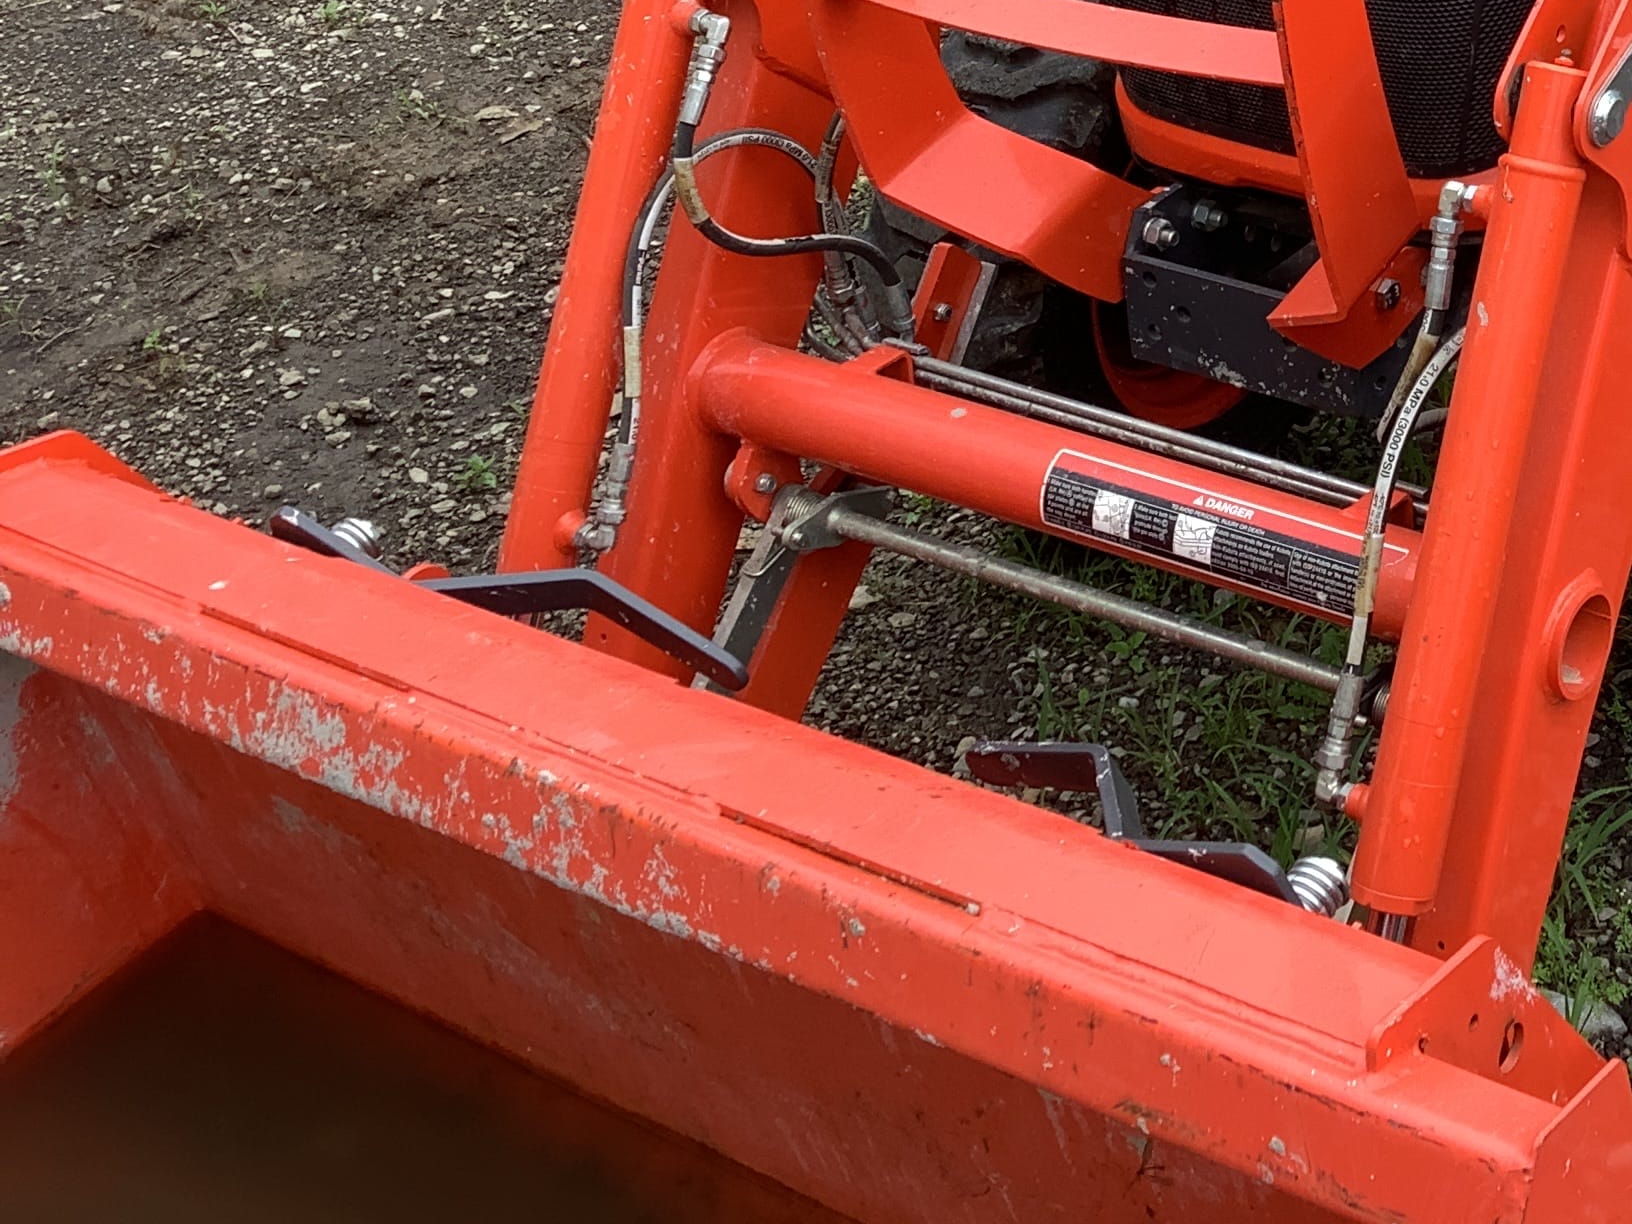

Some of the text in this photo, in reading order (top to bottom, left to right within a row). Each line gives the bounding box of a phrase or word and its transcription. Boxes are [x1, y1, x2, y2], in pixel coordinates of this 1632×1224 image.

[1380, 363, 1440, 480] 21.0 MPa (3000 PSI)
[1205, 497, 1255, 521] DANGER
